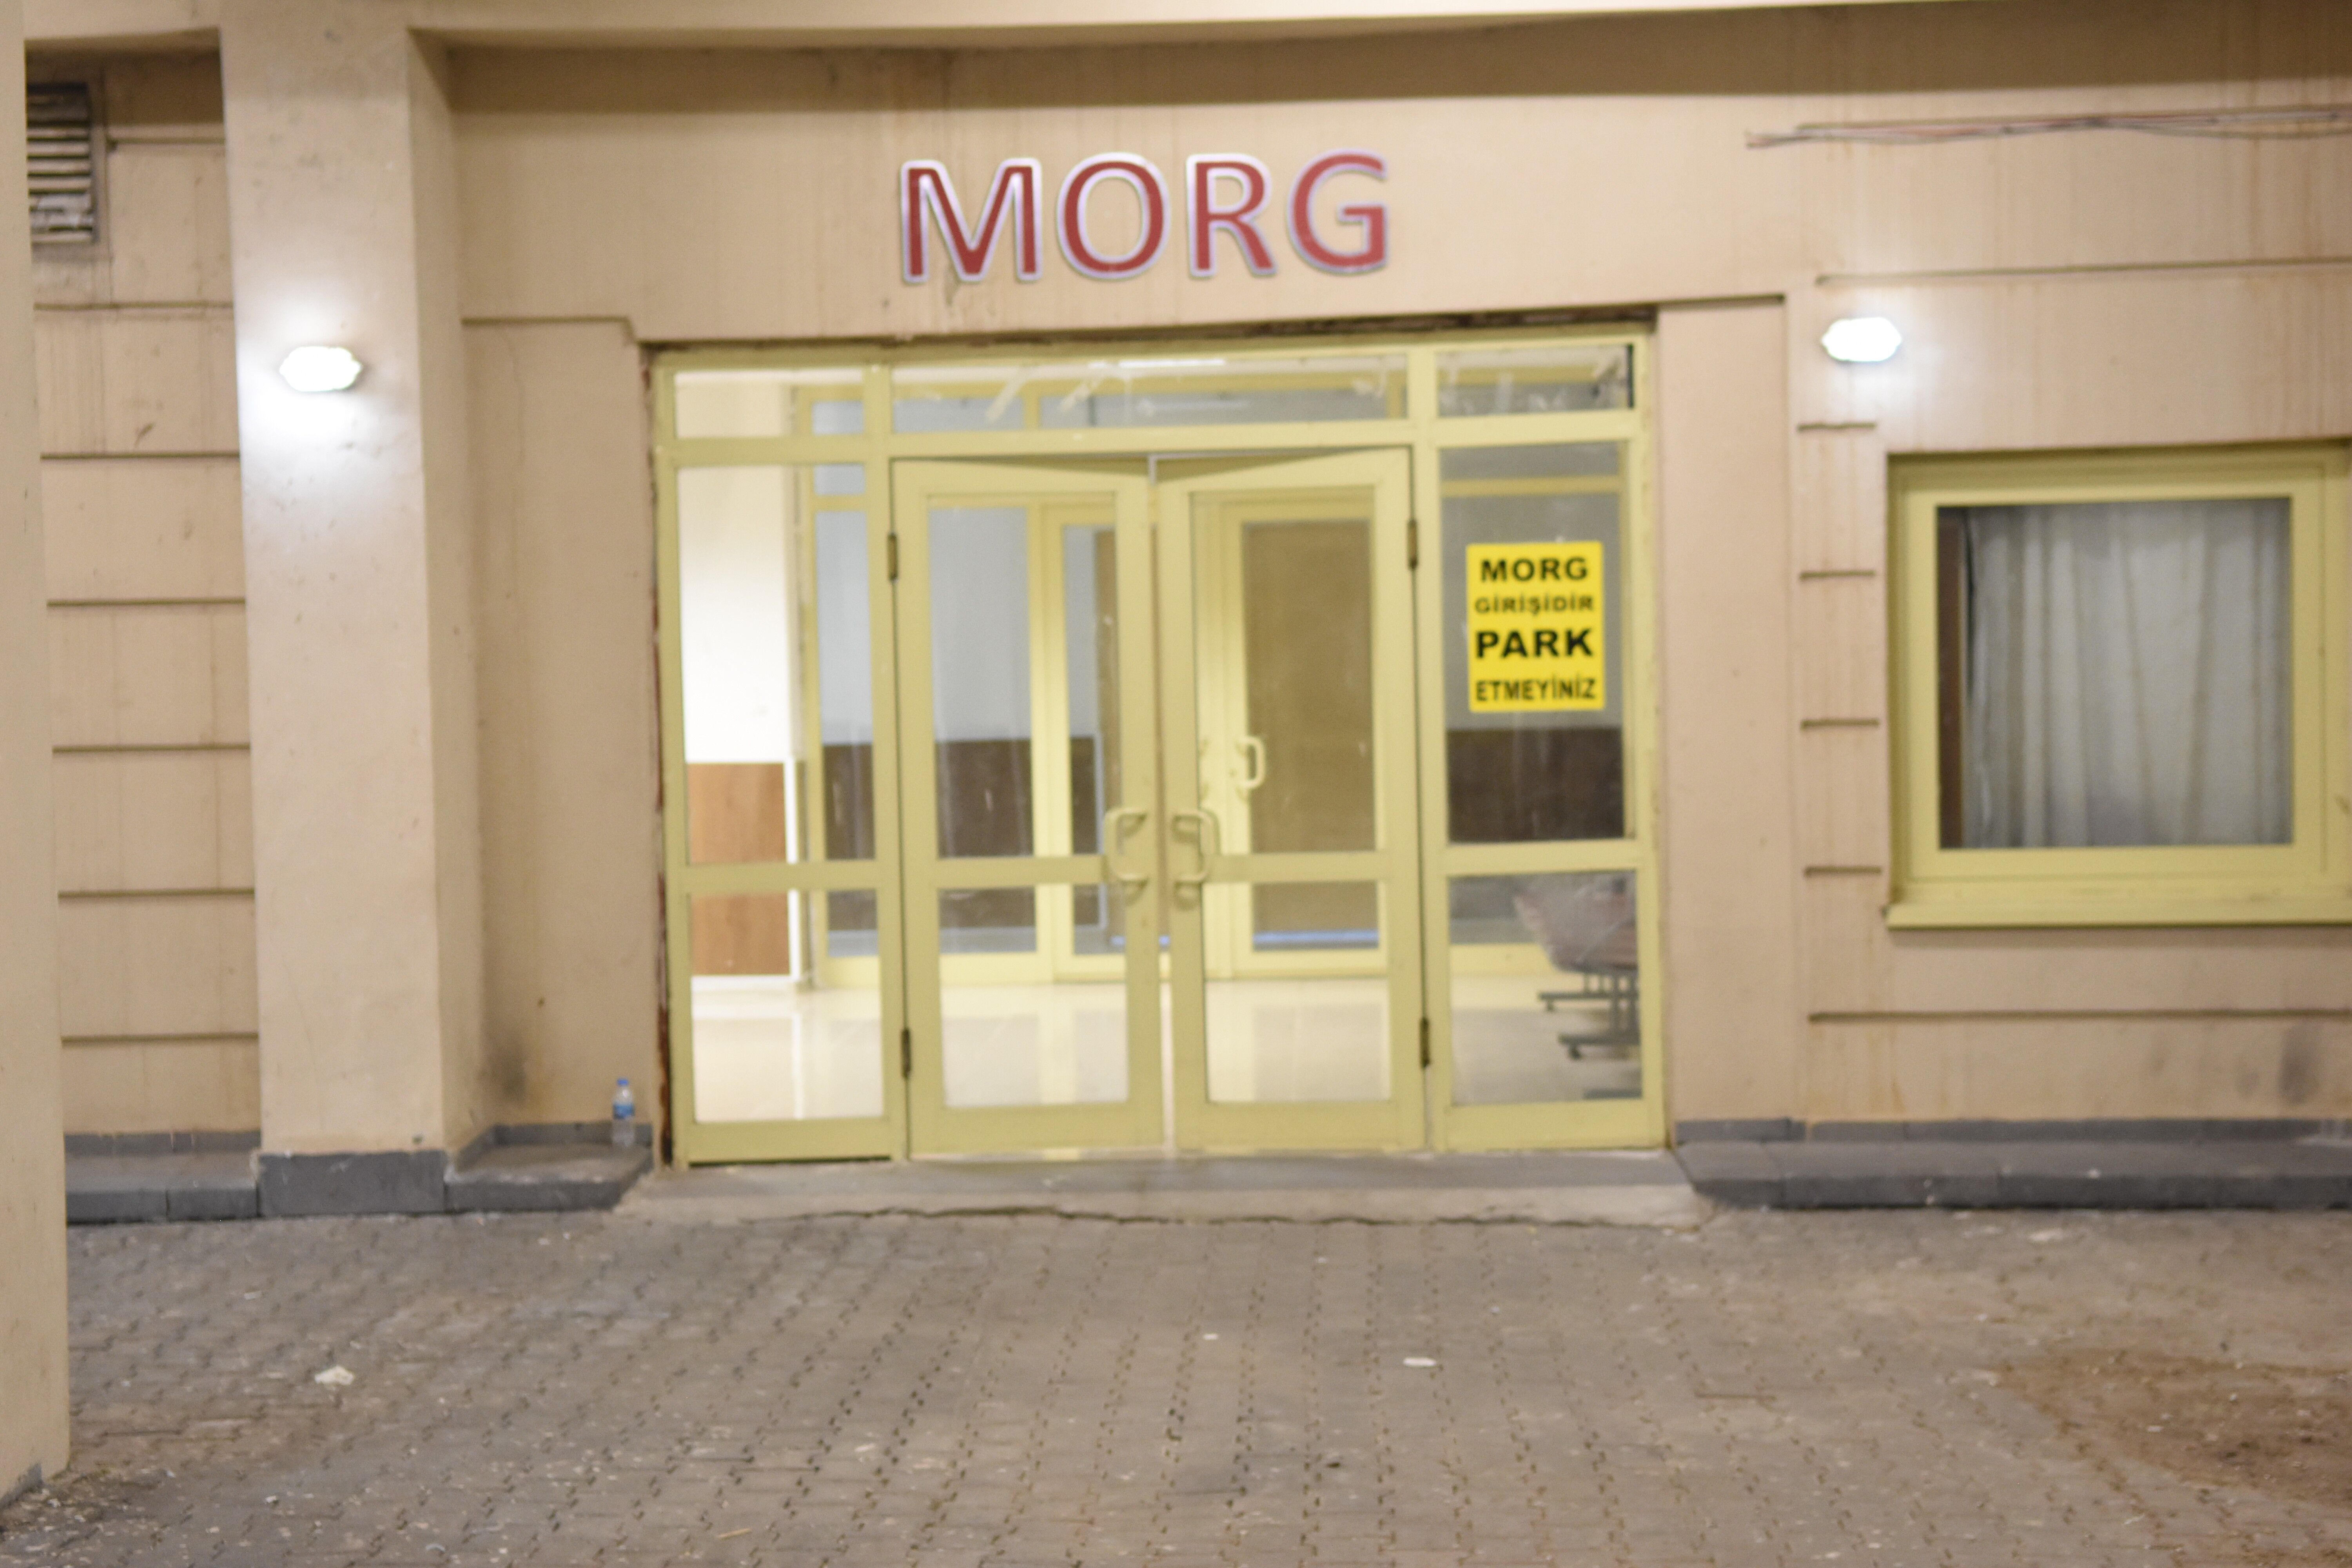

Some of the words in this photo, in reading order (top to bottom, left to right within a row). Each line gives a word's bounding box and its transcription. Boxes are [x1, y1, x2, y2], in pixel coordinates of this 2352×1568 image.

[900, 149, 1388, 283] MORG
[1481, 557, 1587, 582] MORG
[1475, 593, 1593, 617] GİRİŞİDİR
[1476, 629, 1592, 658] PARK
[1476, 673, 1595, 701] ETMEYİNİZ
